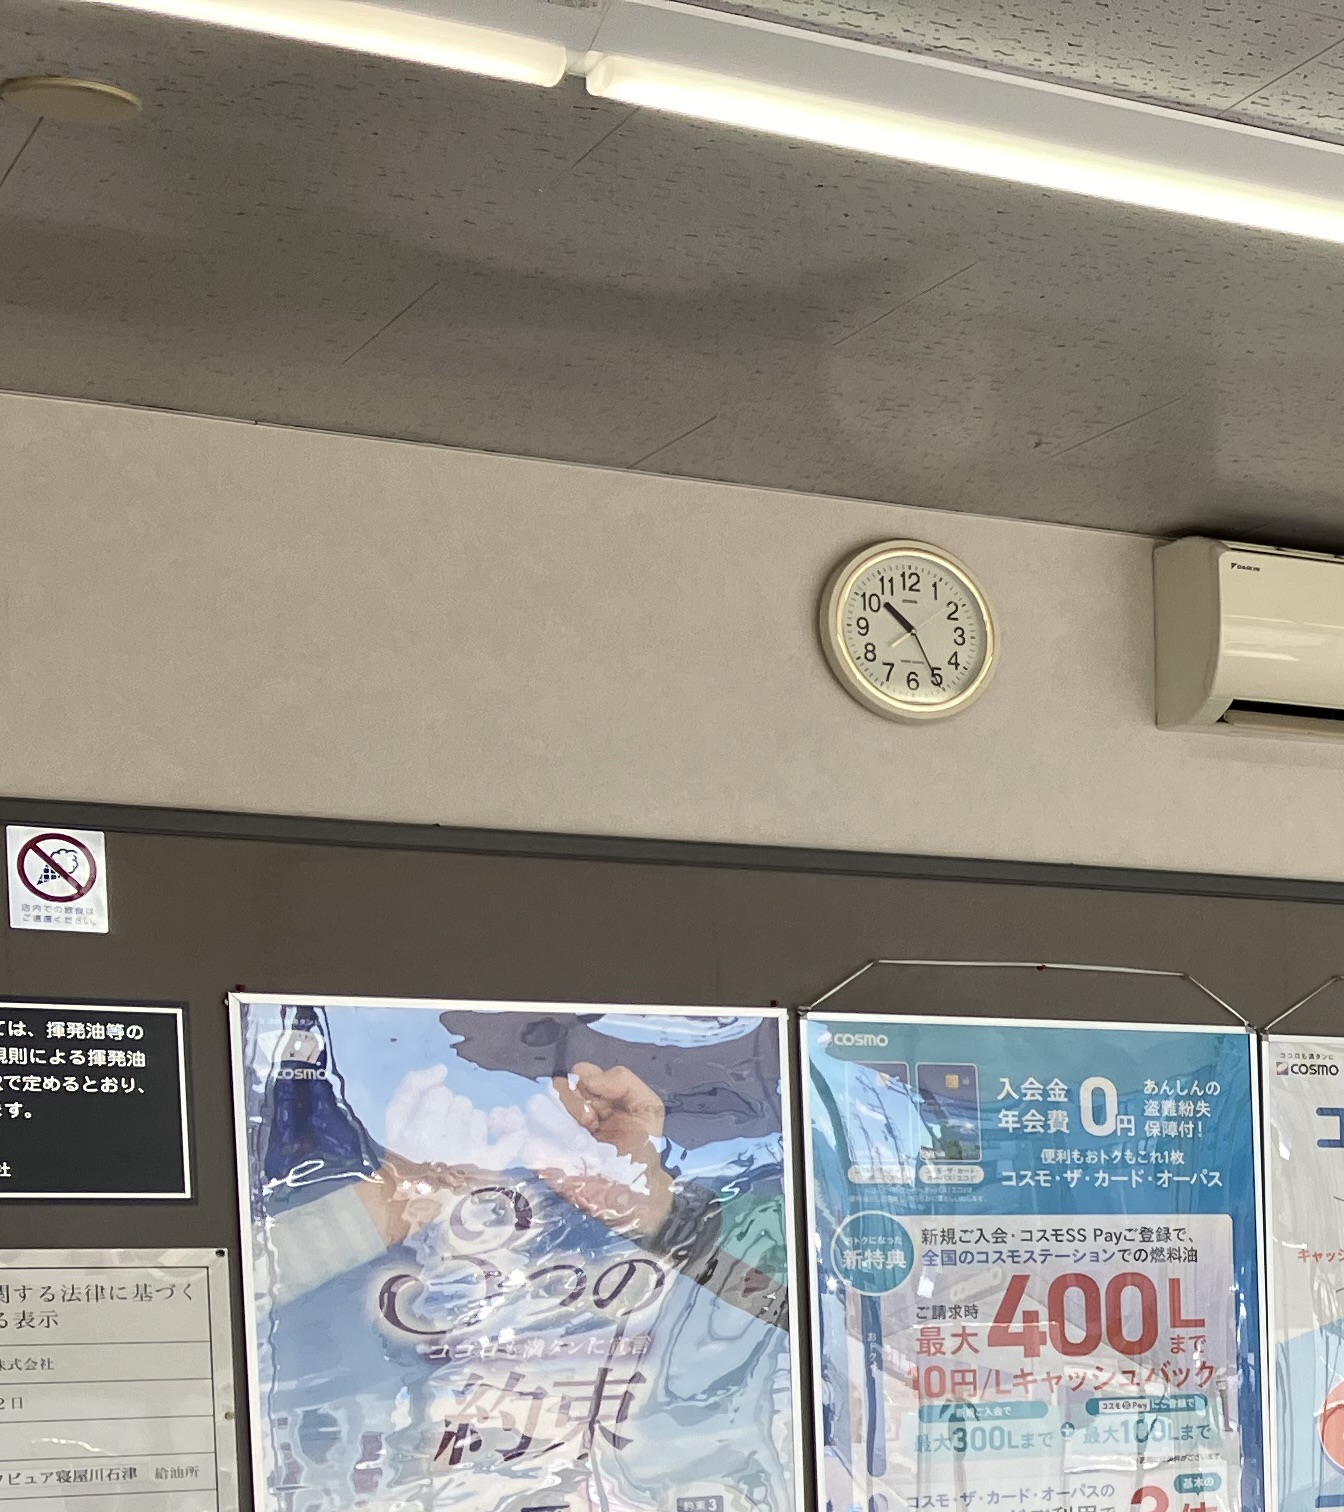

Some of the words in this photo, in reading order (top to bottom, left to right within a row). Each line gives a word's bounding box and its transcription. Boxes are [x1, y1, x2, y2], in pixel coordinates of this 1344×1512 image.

[879, 575, 894, 596] 11
[900, 571, 920, 592] 12
[931, 581, 938, 601] 1
[860, 592, 881, 613] 10
[946, 601, 959, 621] 2
[856, 616, 870, 636] 9
[953, 626, 966, 646] 3
[864, 642, 877, 662] 8
[948, 651, 961, 670] 4
[882, 661, 895, 682] 7
[906, 671, 920, 691] 6
[931, 667, 943, 687] 5
[833, 1033, 889, 1047] COSMO
[1279, 1052, 1334, 1061] ココロも満タンに
[1290, 1062, 1340, 1076] COSMO
[0, 1075, 145, 1094] で定めるとおり、
[996, 1076, 1069, 1102] 入会金
[1143, 1078, 1221, 1097] あんしんの
[0, 1101, 32, 1119] す。
[1079, 1076, 1136, 1137] 0円
[1143, 1099, 1212, 1118] 盗難紛失
[997, 1109, 1071, 1135] 年会費
[1040, 1148, 1186, 1166] 便利もおトクもこれ1枚
[1001, 1168, 1223, 1189] コスモ・ザ・カード・オーパス
[842, 1250, 907, 1270] 新特典
[921, 1246, 1199, 1267] 全国のコスモステーションでの燃料油
[915, 1303, 979, 1321] ご請求時
[915, 1325, 979, 1357] 最大
[987, 1271, 1206, 1359] 400L
[1169, 1333, 1208, 1355] まで
[433, 1366, 647, 1466] 約束
[0, 1466, 138, 1486] ピュア寝屋川石津
[154, 1465, 200, 1480] 給油所
[1182, 1476, 1216, 1488] 基本の
